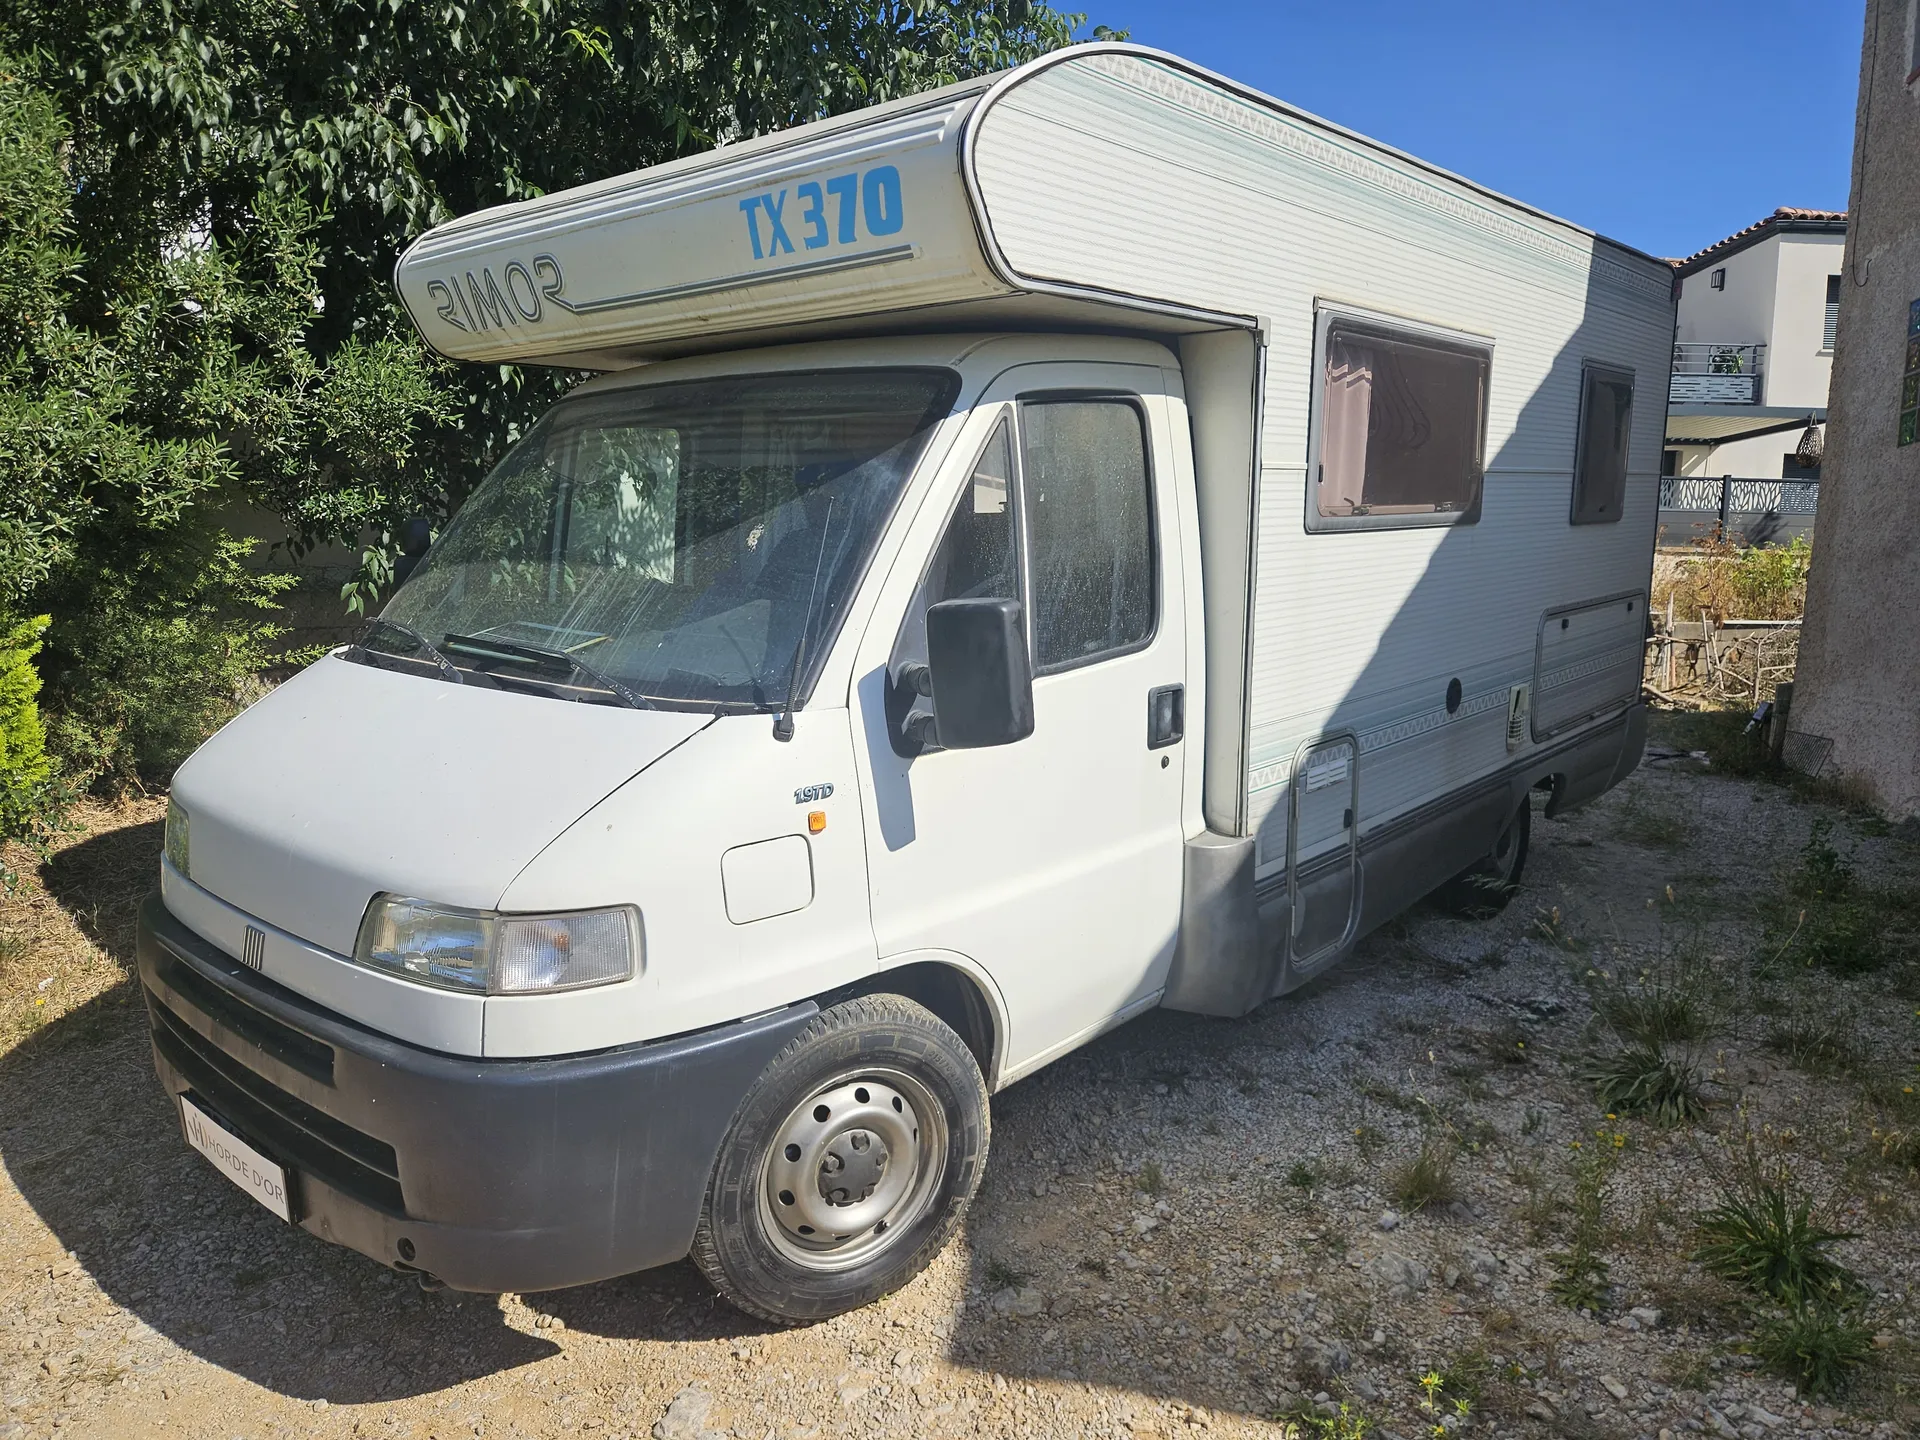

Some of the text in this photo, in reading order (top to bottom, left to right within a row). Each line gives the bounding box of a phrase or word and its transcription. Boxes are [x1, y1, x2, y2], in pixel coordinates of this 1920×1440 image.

[427, 253, 577, 333] RIMOR
[208, 1135, 284, 1204] HORDE D'OR
